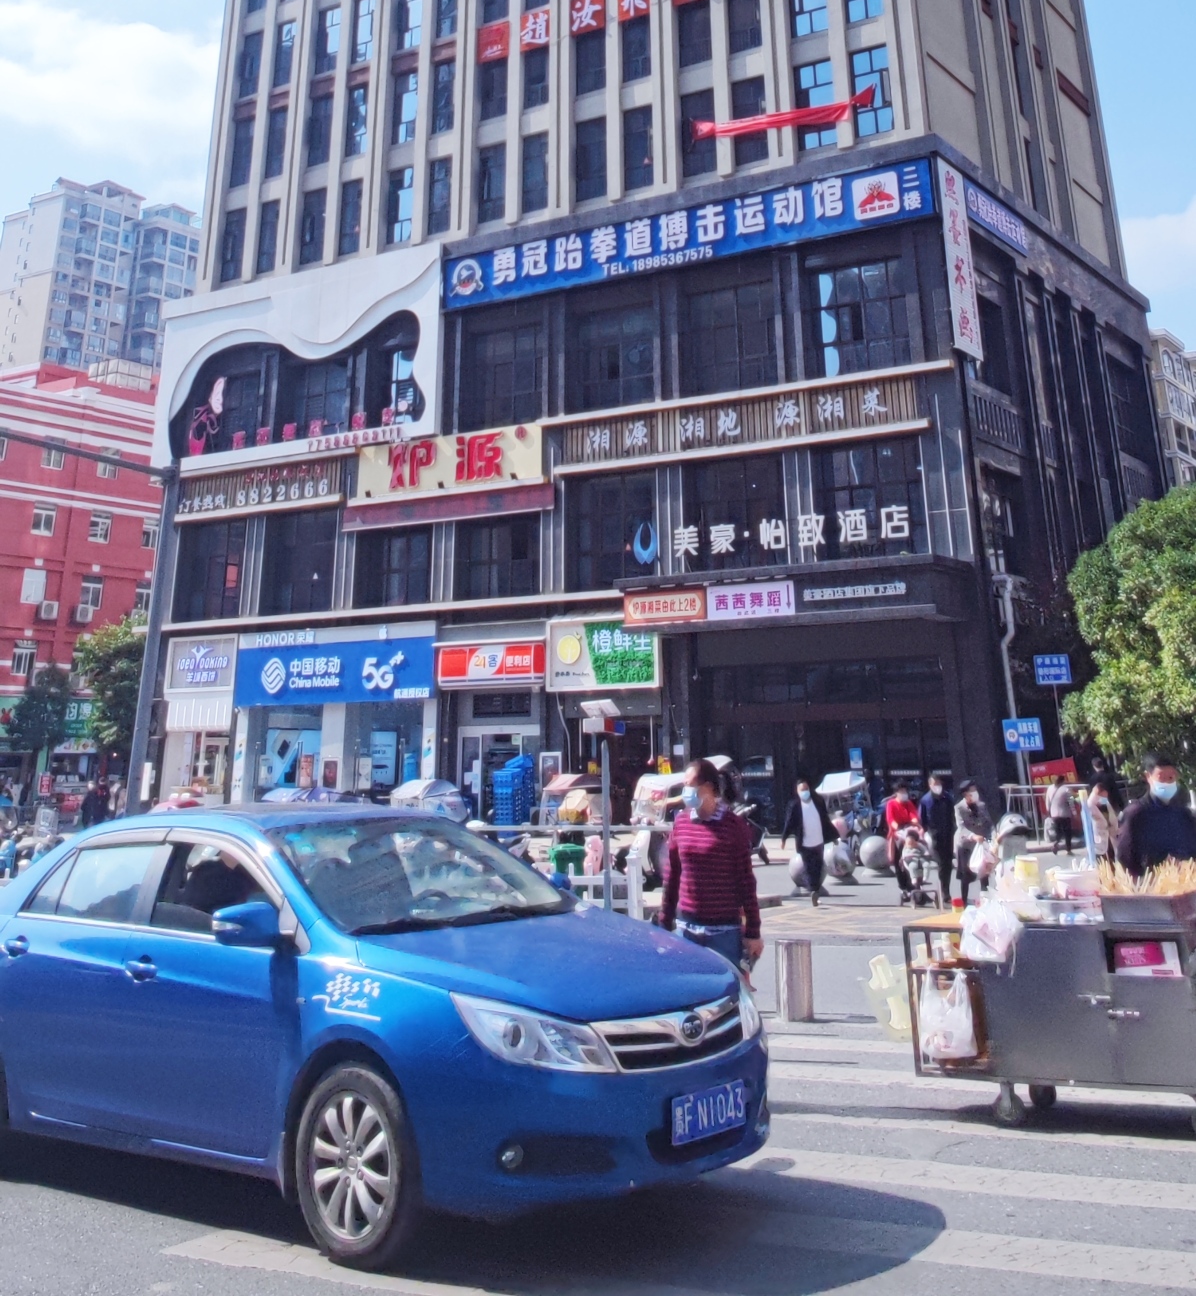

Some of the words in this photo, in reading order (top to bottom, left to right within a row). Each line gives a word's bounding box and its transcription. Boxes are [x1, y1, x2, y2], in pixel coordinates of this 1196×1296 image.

[492, 176, 844, 285] 勇冠跆拳道搏击运动馆
[631, 245, 714, 273] 18985367575
[235, 478, 329, 507] 8822666
[714, 590, 782, 612] 茜茜舞蹈
[256, 632, 295, 647] HONOR
[289, 655, 341, 677] 中国移动
[289, 676, 311, 689] China
[312, 674, 340, 688] Mobile
